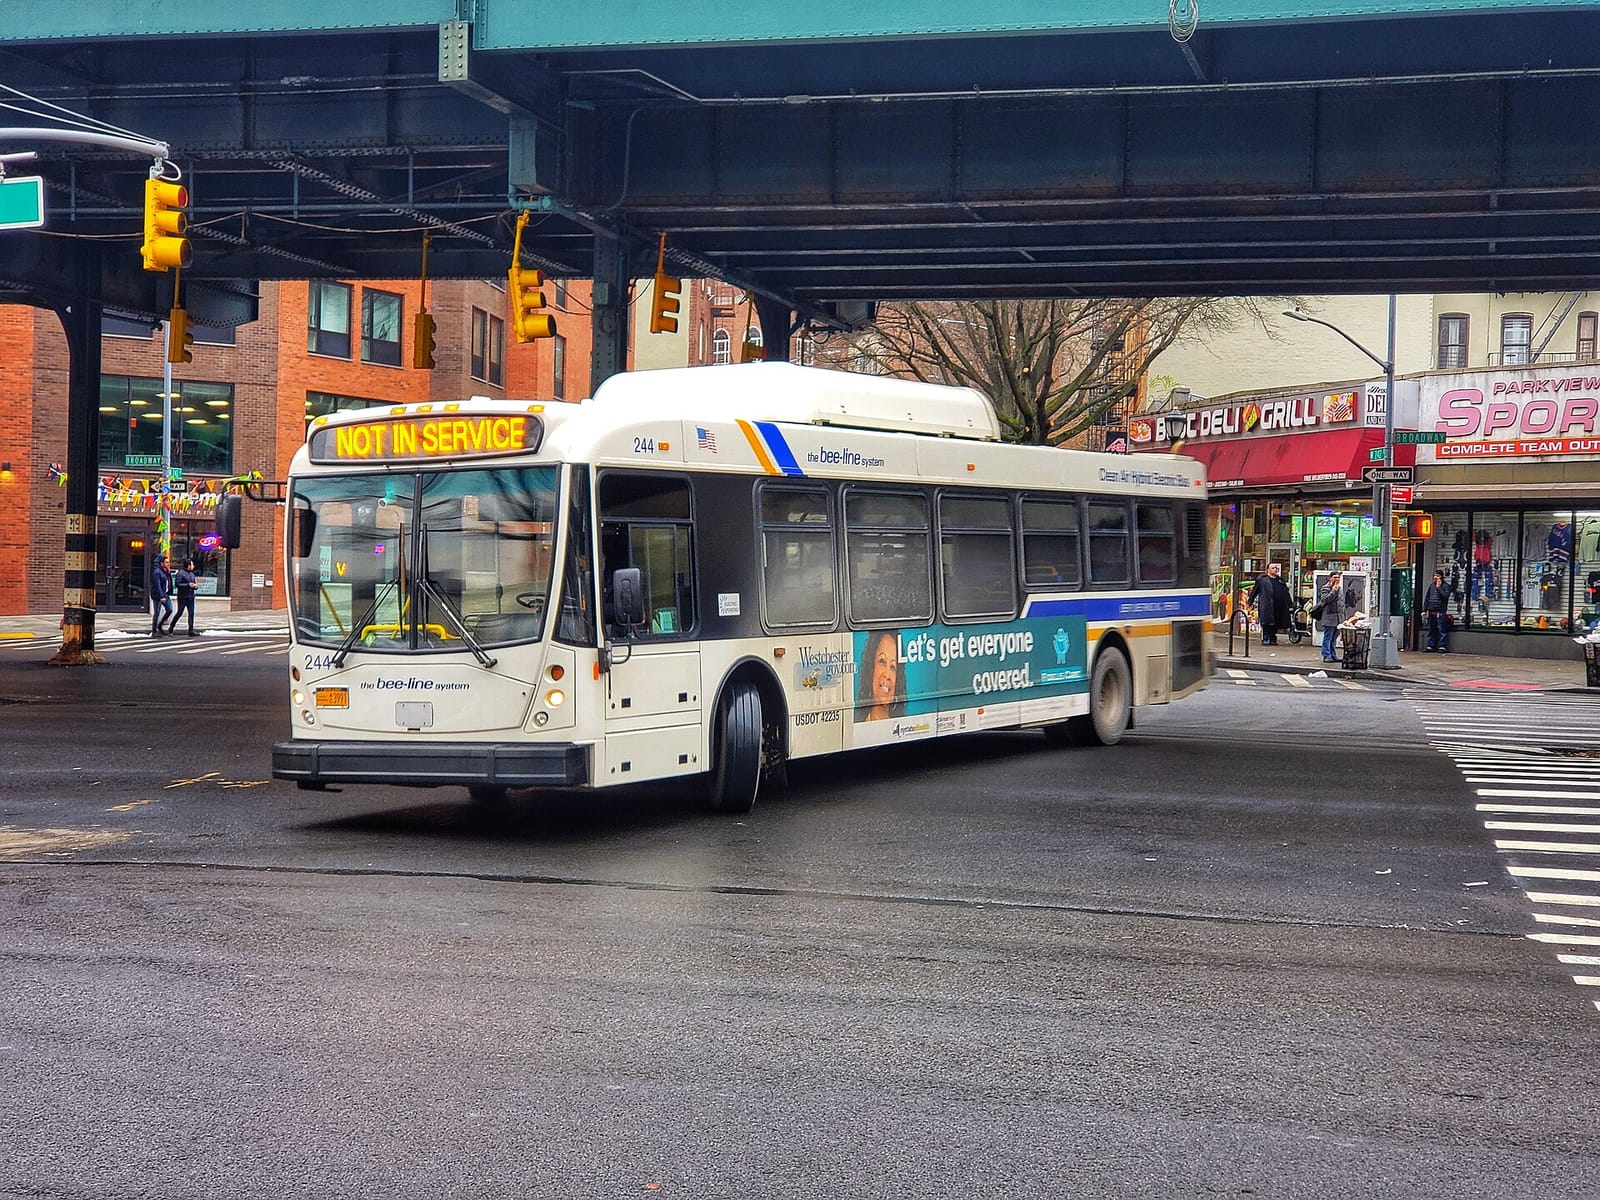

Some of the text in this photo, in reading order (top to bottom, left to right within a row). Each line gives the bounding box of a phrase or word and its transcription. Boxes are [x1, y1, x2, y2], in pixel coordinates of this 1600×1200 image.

[1494, 377, 1600, 395] PARKVIEW
[1200, 406, 1240, 436] DELI
[1260, 397, 1318, 430] GRILL
[335, 416, 525, 457] NOT IN SERVICE
[633, 436, 654, 454] 244
[1396, 434, 1446, 443] BROADWAY
[807, 446, 885, 467] the bee-line system
[1441, 444, 1514, 455] COMPLETE
[1520, 441, 1562, 451] TEAM
[126, 456, 161, 465] BROADWAY
[1371, 471, 1408, 479] ONE WAY
[799, 646, 850, 669] Westchester
[897, 630, 1034, 668] Let's get everyone
[304, 654, 332, 670] 244
[360, 677, 470, 691] the bee-line system
[972, 662, 1034, 695] covered.
[795, 710, 840, 726] USDOT 42235
